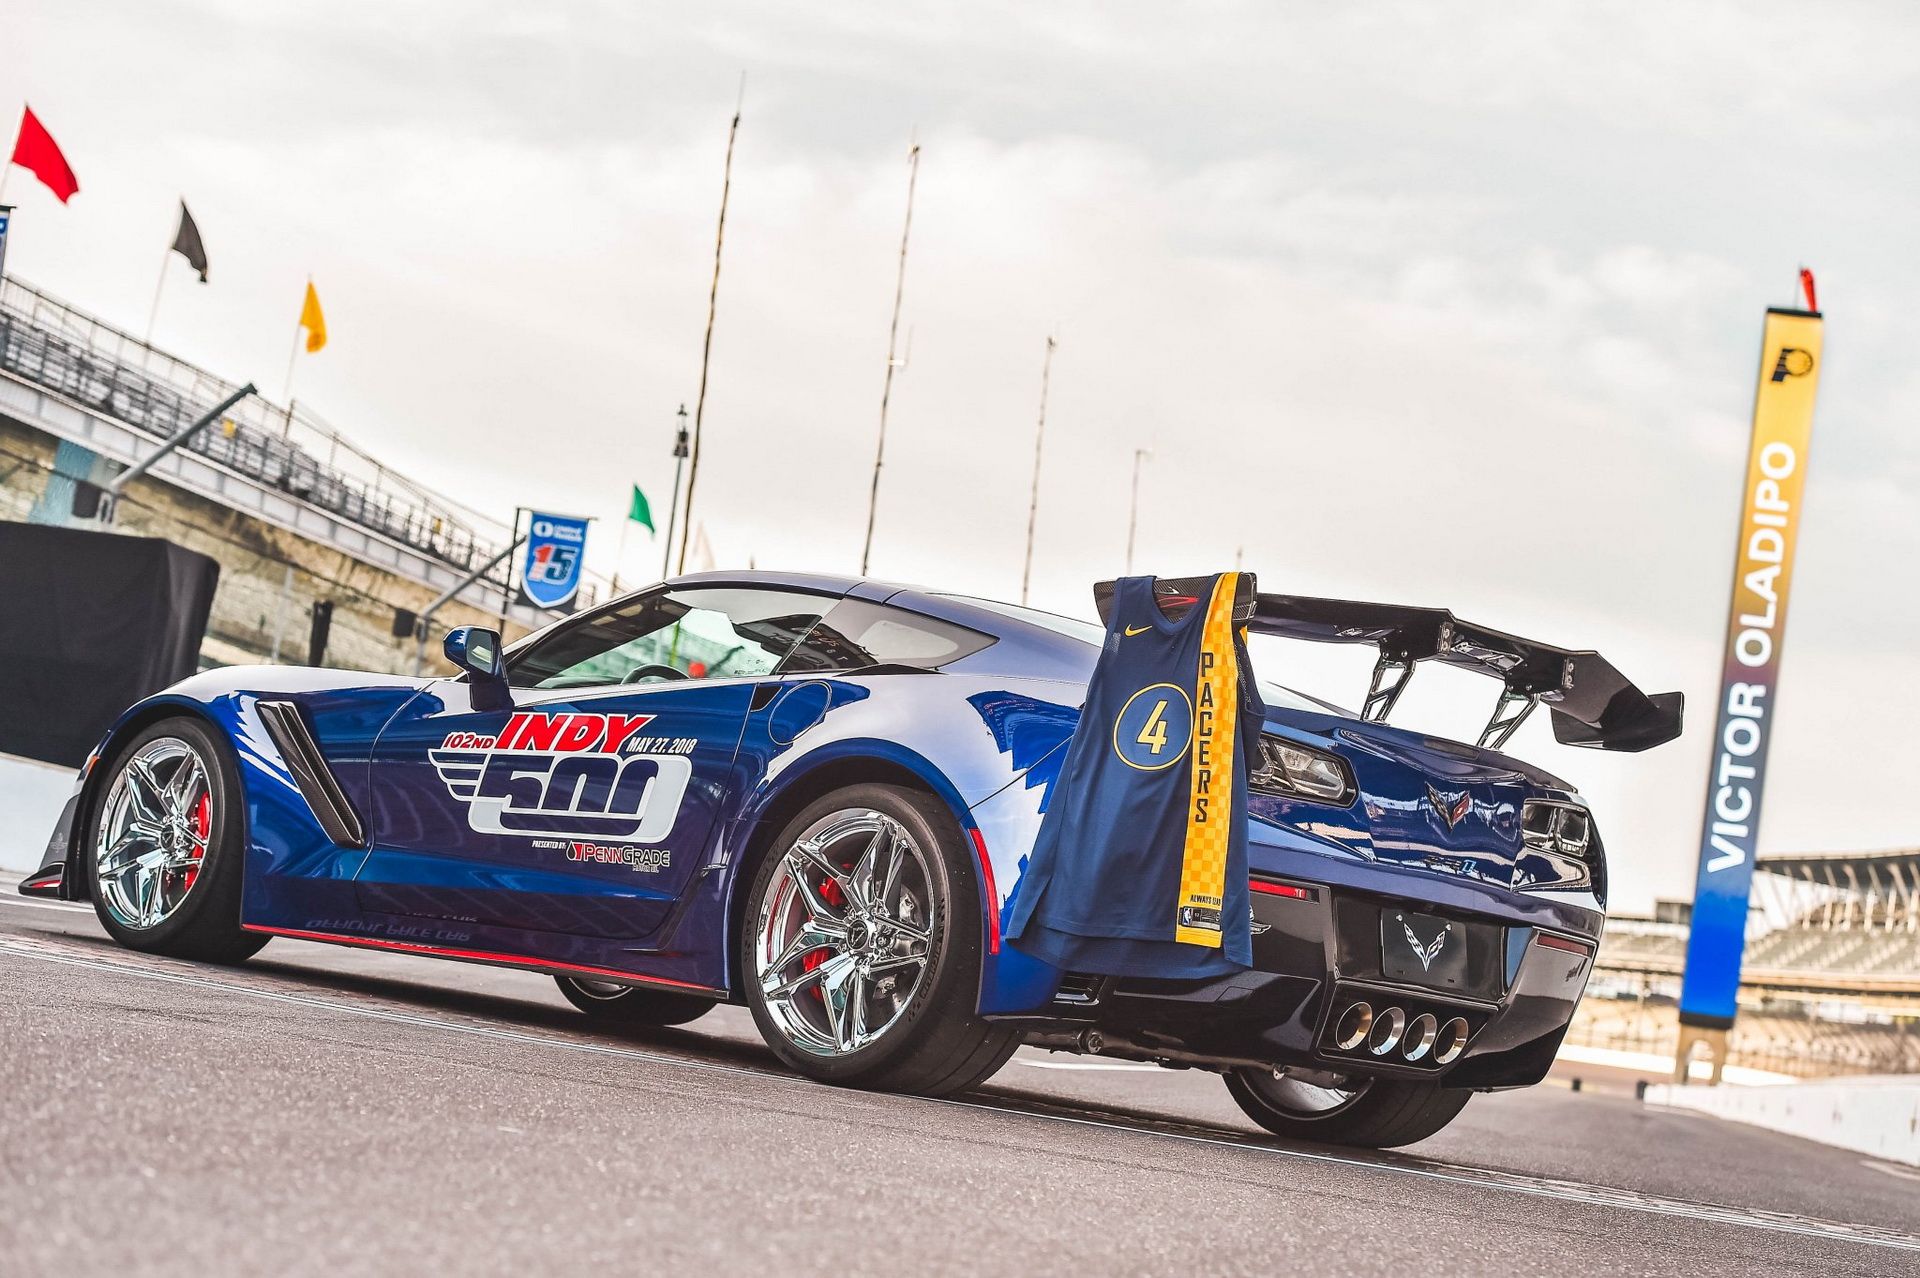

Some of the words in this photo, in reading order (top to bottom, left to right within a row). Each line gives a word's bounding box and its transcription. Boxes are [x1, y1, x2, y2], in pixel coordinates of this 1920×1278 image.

[1735, 441, 1796, 667] OLADIPO
[442, 732, 496, 750] 102ND
[494, 711, 657, 754] INDY
[625, 736, 656, 753] MAY
[667, 738, 698, 755] 2018
[1136, 699, 1168, 755] 4
[1194, 651, 1214, 823] PACERS
[467, 750, 693, 843] 500
[1707, 682, 1767, 873] VICTOR
